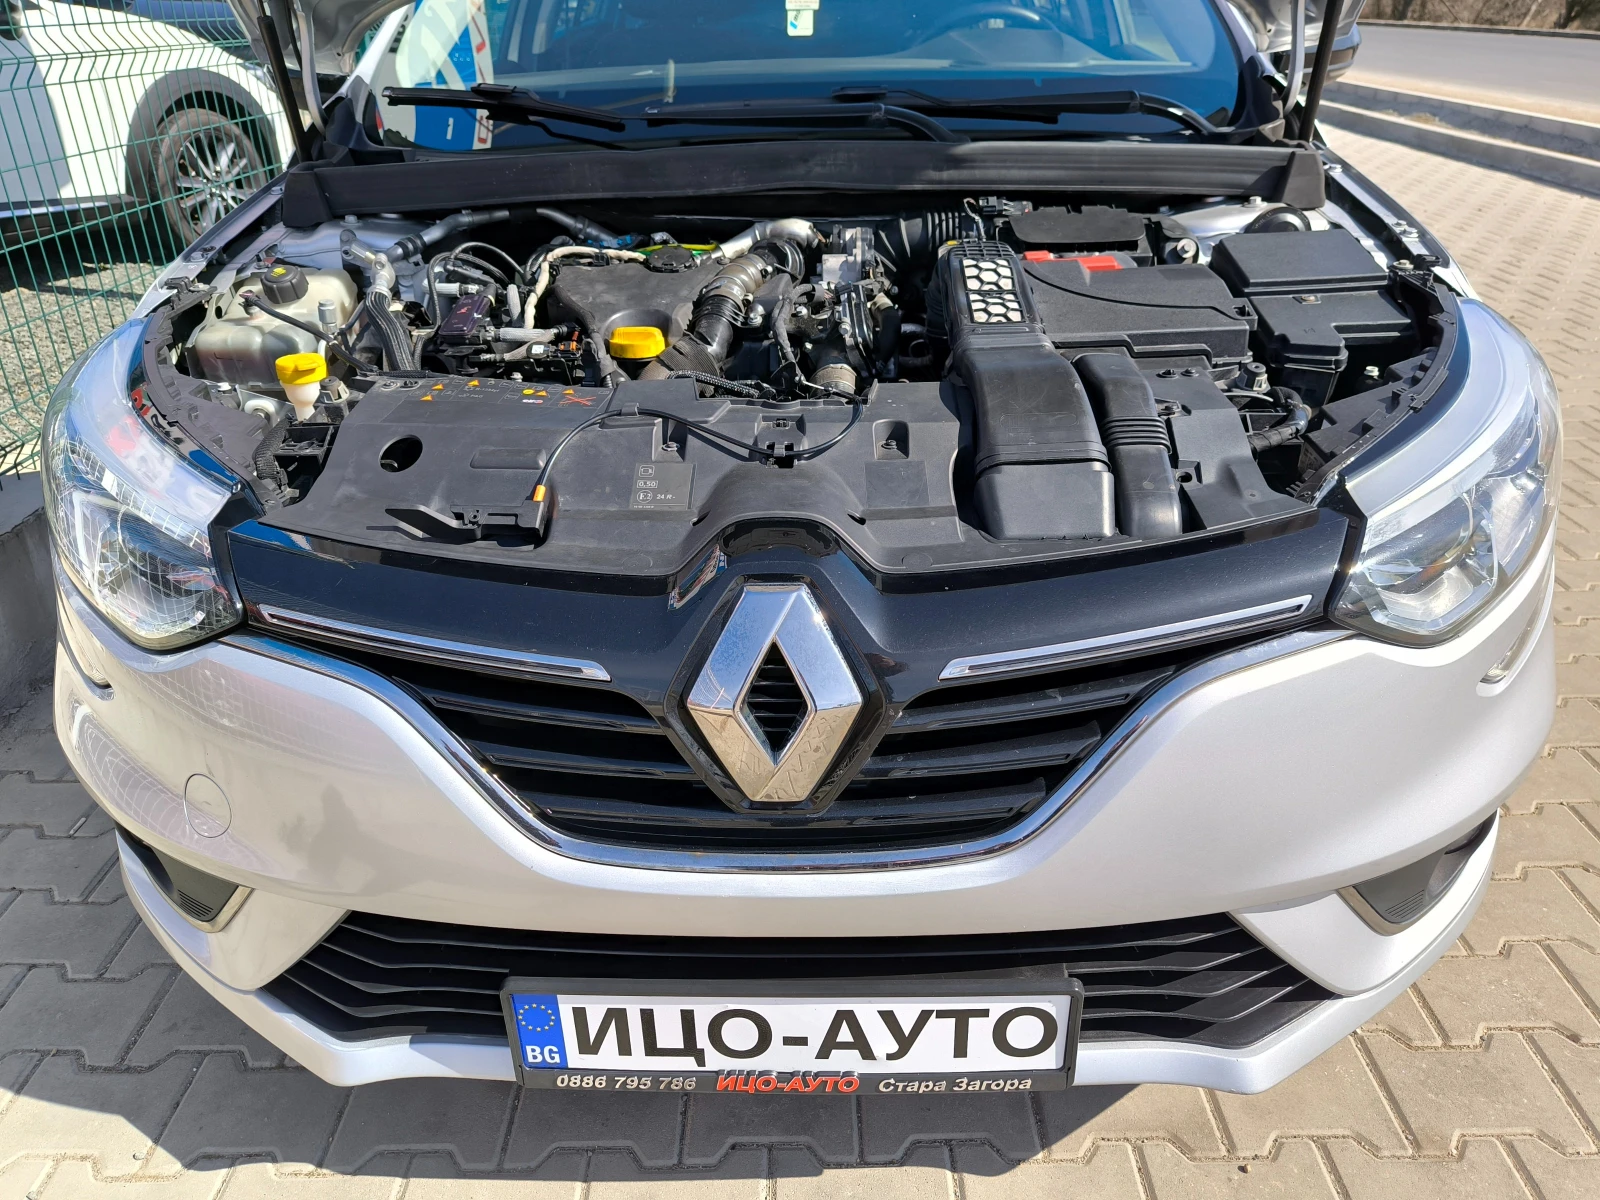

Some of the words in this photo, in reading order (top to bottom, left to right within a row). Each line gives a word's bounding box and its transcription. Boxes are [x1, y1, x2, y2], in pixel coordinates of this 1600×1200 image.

[571, 1006, 1059, 1067] ИЦО-АУТО
[526, 1045, 561, 1066] BG
[556, 1074, 607, 1089] 0886
[613, 1076, 652, 1090] 795
[658, 1077, 697, 1091] 786
[715, 1073, 860, 1094] ИЦО-АУТО
[878, 1077, 947, 1093] Стара
[952, 1076, 1032, 1092] Загора
